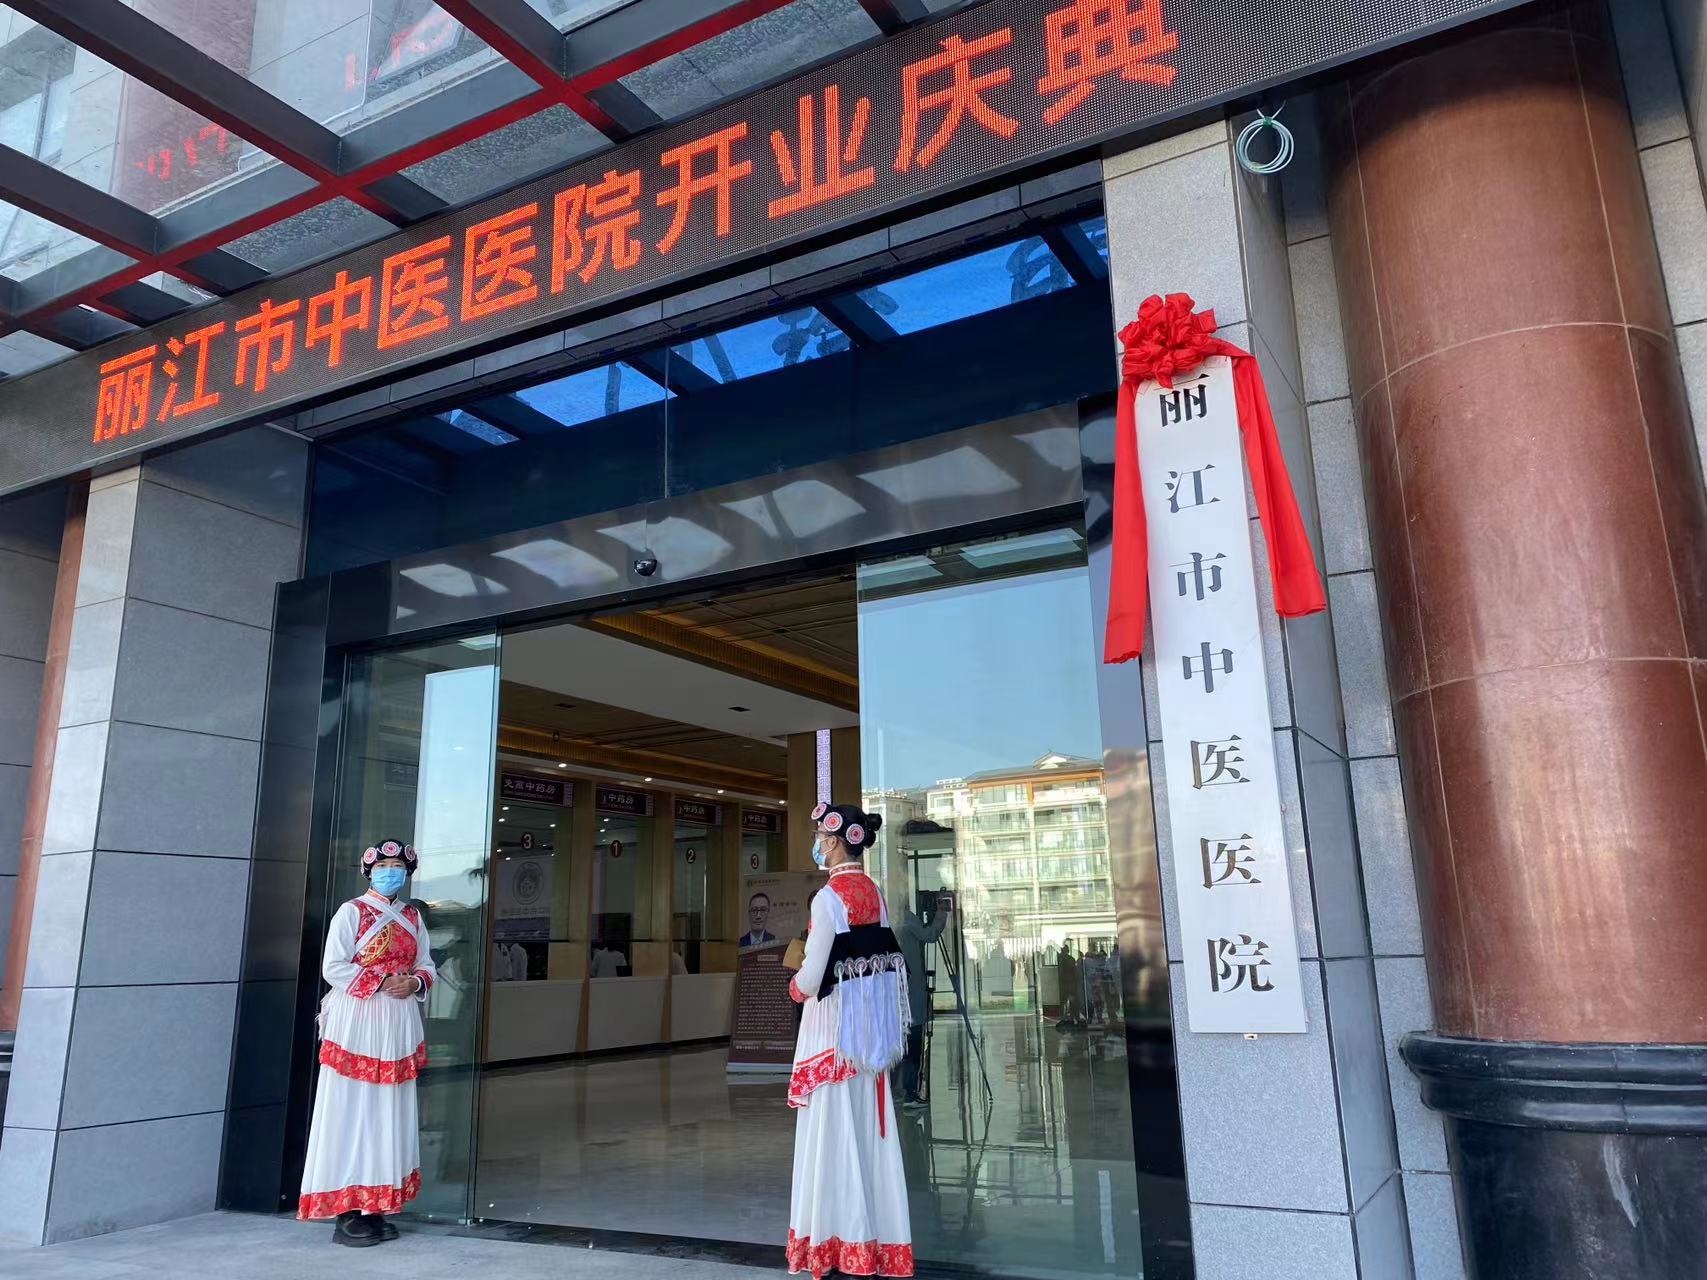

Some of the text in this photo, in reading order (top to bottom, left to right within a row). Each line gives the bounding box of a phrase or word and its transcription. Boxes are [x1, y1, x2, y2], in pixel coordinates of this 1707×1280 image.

[92, 0, 1179, 443] 丽江市中医医院开业庆典
[1153, 373, 1275, 993] 丽江市中医医院
[523, 834, 532, 849] 3
[613, 842, 619, 857] 1
[688, 849, 694, 862] 2
[752, 855, 759, 868] 3
